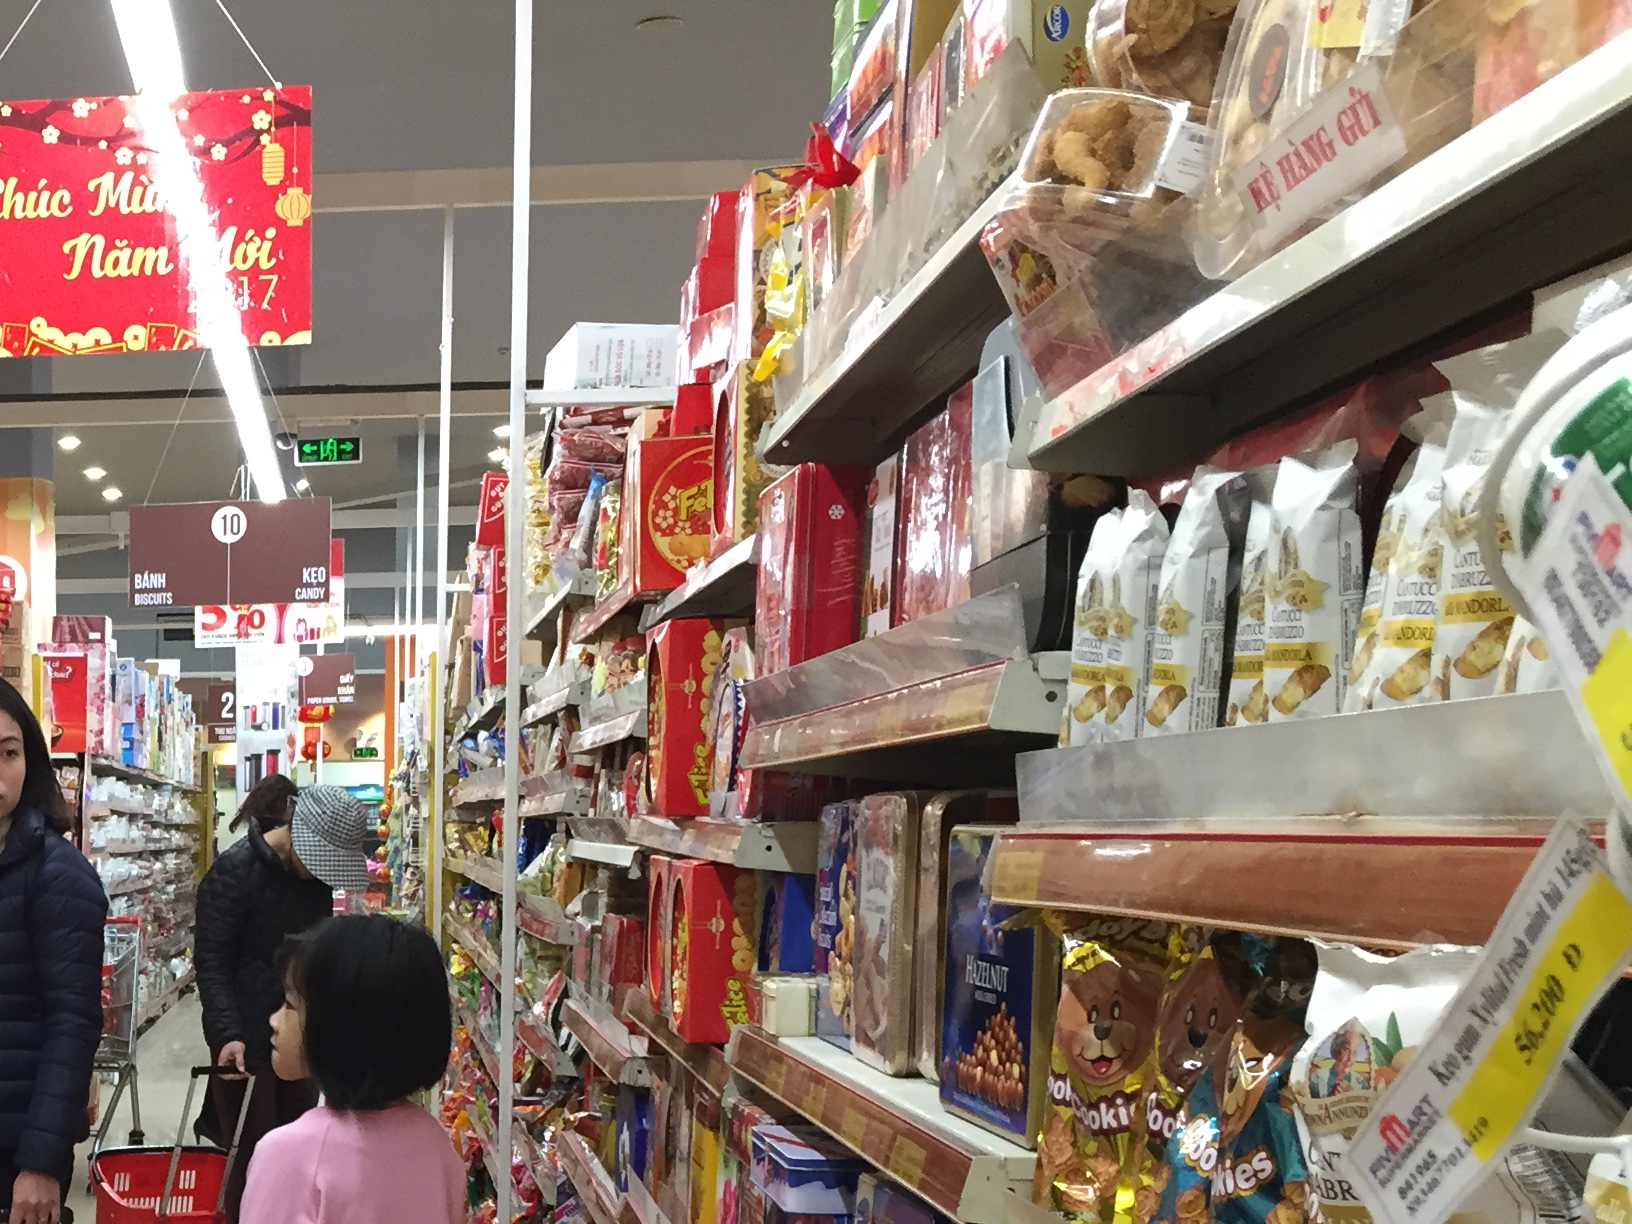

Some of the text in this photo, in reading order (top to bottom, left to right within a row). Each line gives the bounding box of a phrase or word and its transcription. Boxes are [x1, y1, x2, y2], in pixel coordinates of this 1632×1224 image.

[1275, 125, 1338, 192] HÀNG
[88, 171, 173, 217] Mừ
[62, 233, 174, 280] Năm
[220, 513, 241, 536] 10
[134, 569, 166, 589] BÁNH
[302, 566, 327, 587] KẸO
[134, 593, 173, 606] BISCUITS
[295, 587, 326, 600] CANDY
[221, 692, 234, 719] 2
[966, 954, 1009, 993] HAZELNUT
[1072, 1096, 1135, 1132] Cooki
